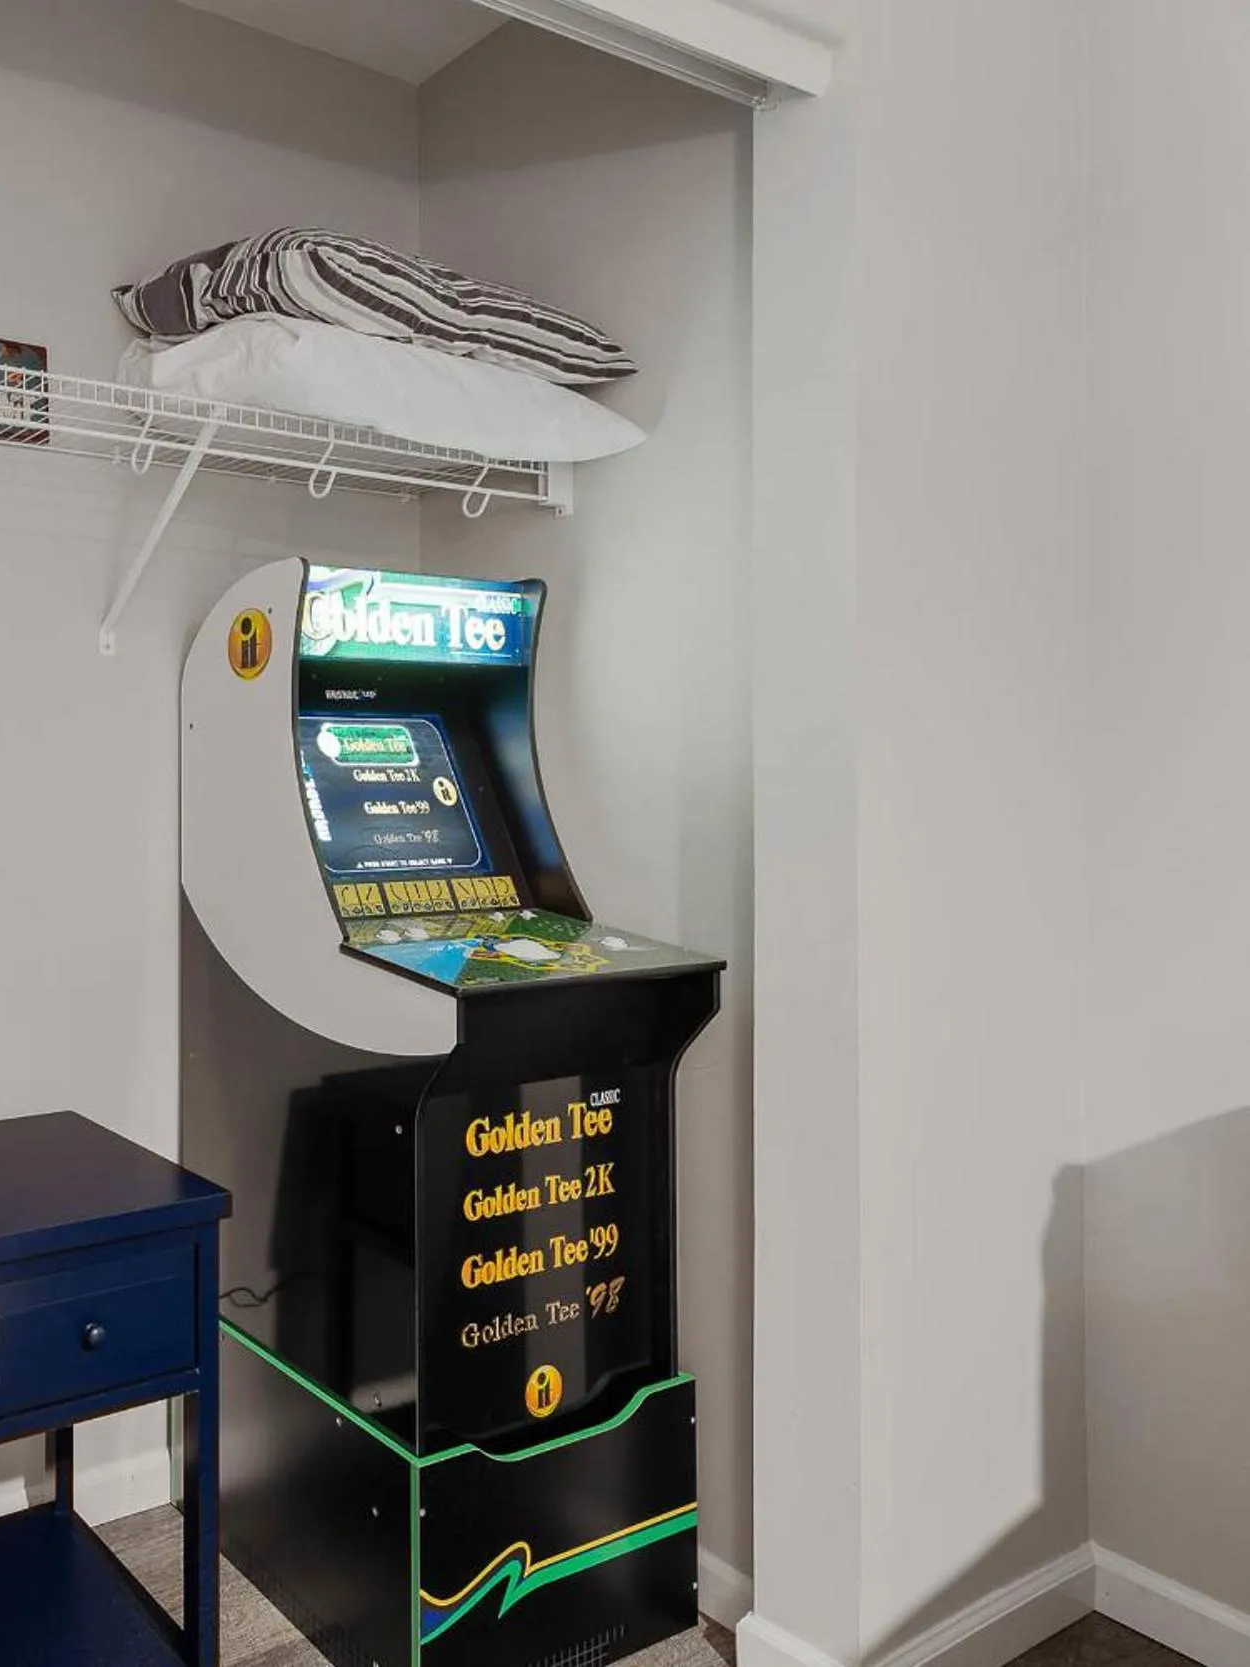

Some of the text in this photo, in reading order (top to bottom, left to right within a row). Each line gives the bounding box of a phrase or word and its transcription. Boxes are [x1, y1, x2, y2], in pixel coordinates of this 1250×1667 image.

[440, 602, 507, 652] Tee
[465, 1100, 614, 1158] Golden Tee
[463, 1162, 617, 1222] Golden Tee 2K
[461, 1244, 546, 1290] Golden
[549, 1233, 589, 1269] Tee
[461, 1311, 540, 1348] Golden
[545, 1299, 581, 1326] Tee
